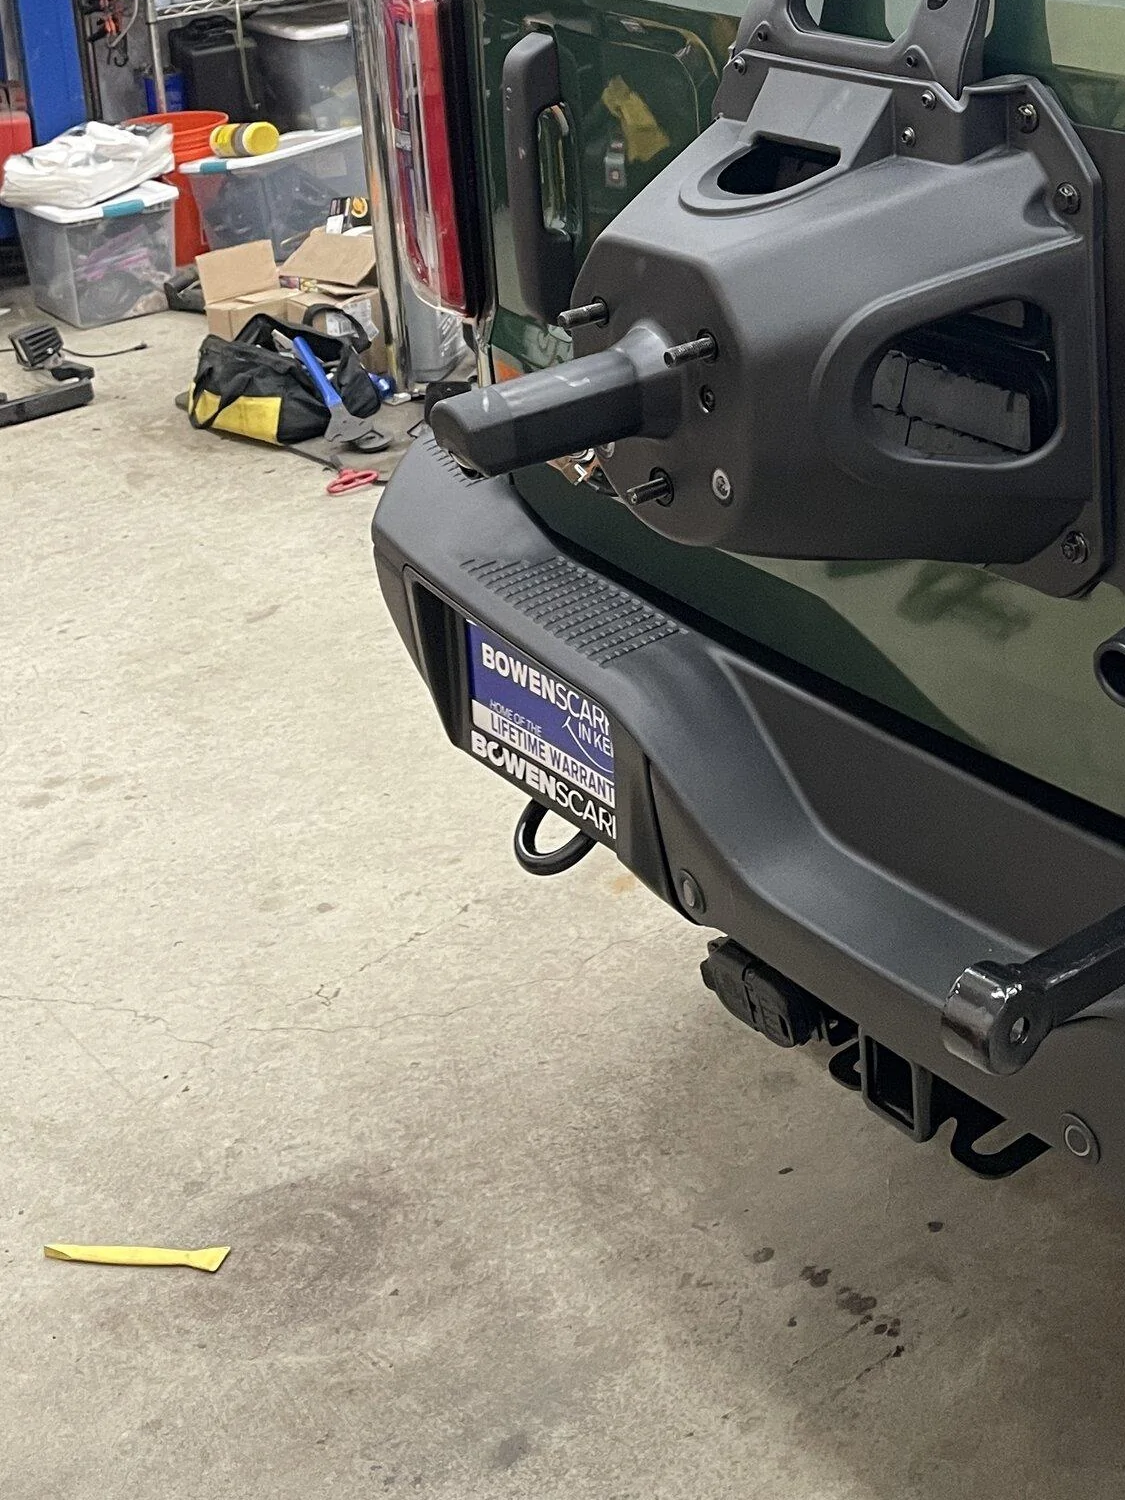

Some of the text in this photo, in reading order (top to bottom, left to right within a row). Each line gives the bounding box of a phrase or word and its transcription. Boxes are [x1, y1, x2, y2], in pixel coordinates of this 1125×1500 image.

[490, 699, 542, 738] HOME OF THE
[490, 712, 546, 762] LIFETIME
[578, 721, 592, 745] IN
[471, 730, 616, 840] BOWENSCAR
